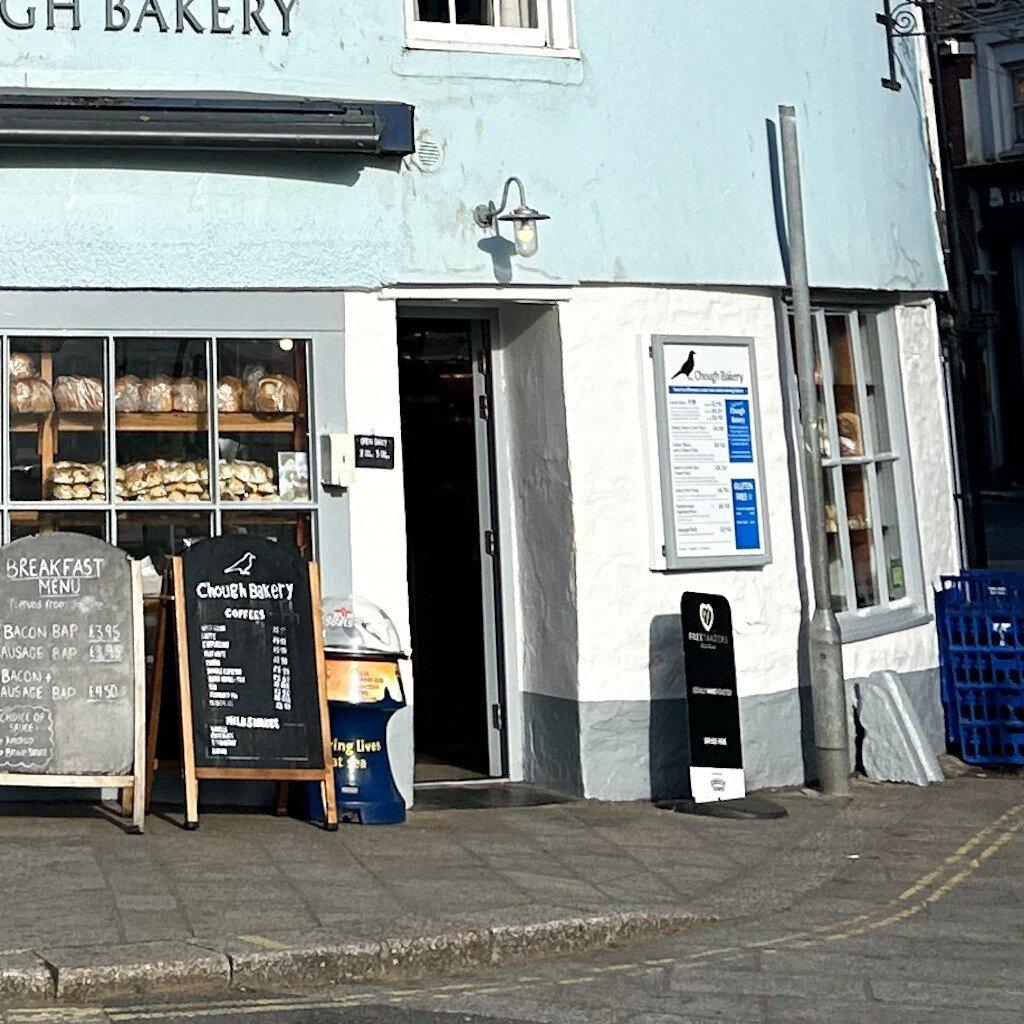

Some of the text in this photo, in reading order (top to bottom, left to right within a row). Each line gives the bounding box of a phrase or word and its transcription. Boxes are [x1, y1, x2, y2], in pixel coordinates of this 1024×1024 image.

[695, 370, 744, 384] Chough Bakery
[6, 557, 104, 579] BREAKFAST
[39, 577, 82, 596] MENU
[195, 581, 294, 601] Chough Bakery
[3, 624, 47, 640] BACON
[52, 623, 79, 639] BAP
[52, 646, 78, 660] BAP
[1, 668, 42, 684] BACON
[52, 686, 77, 701] BAP
